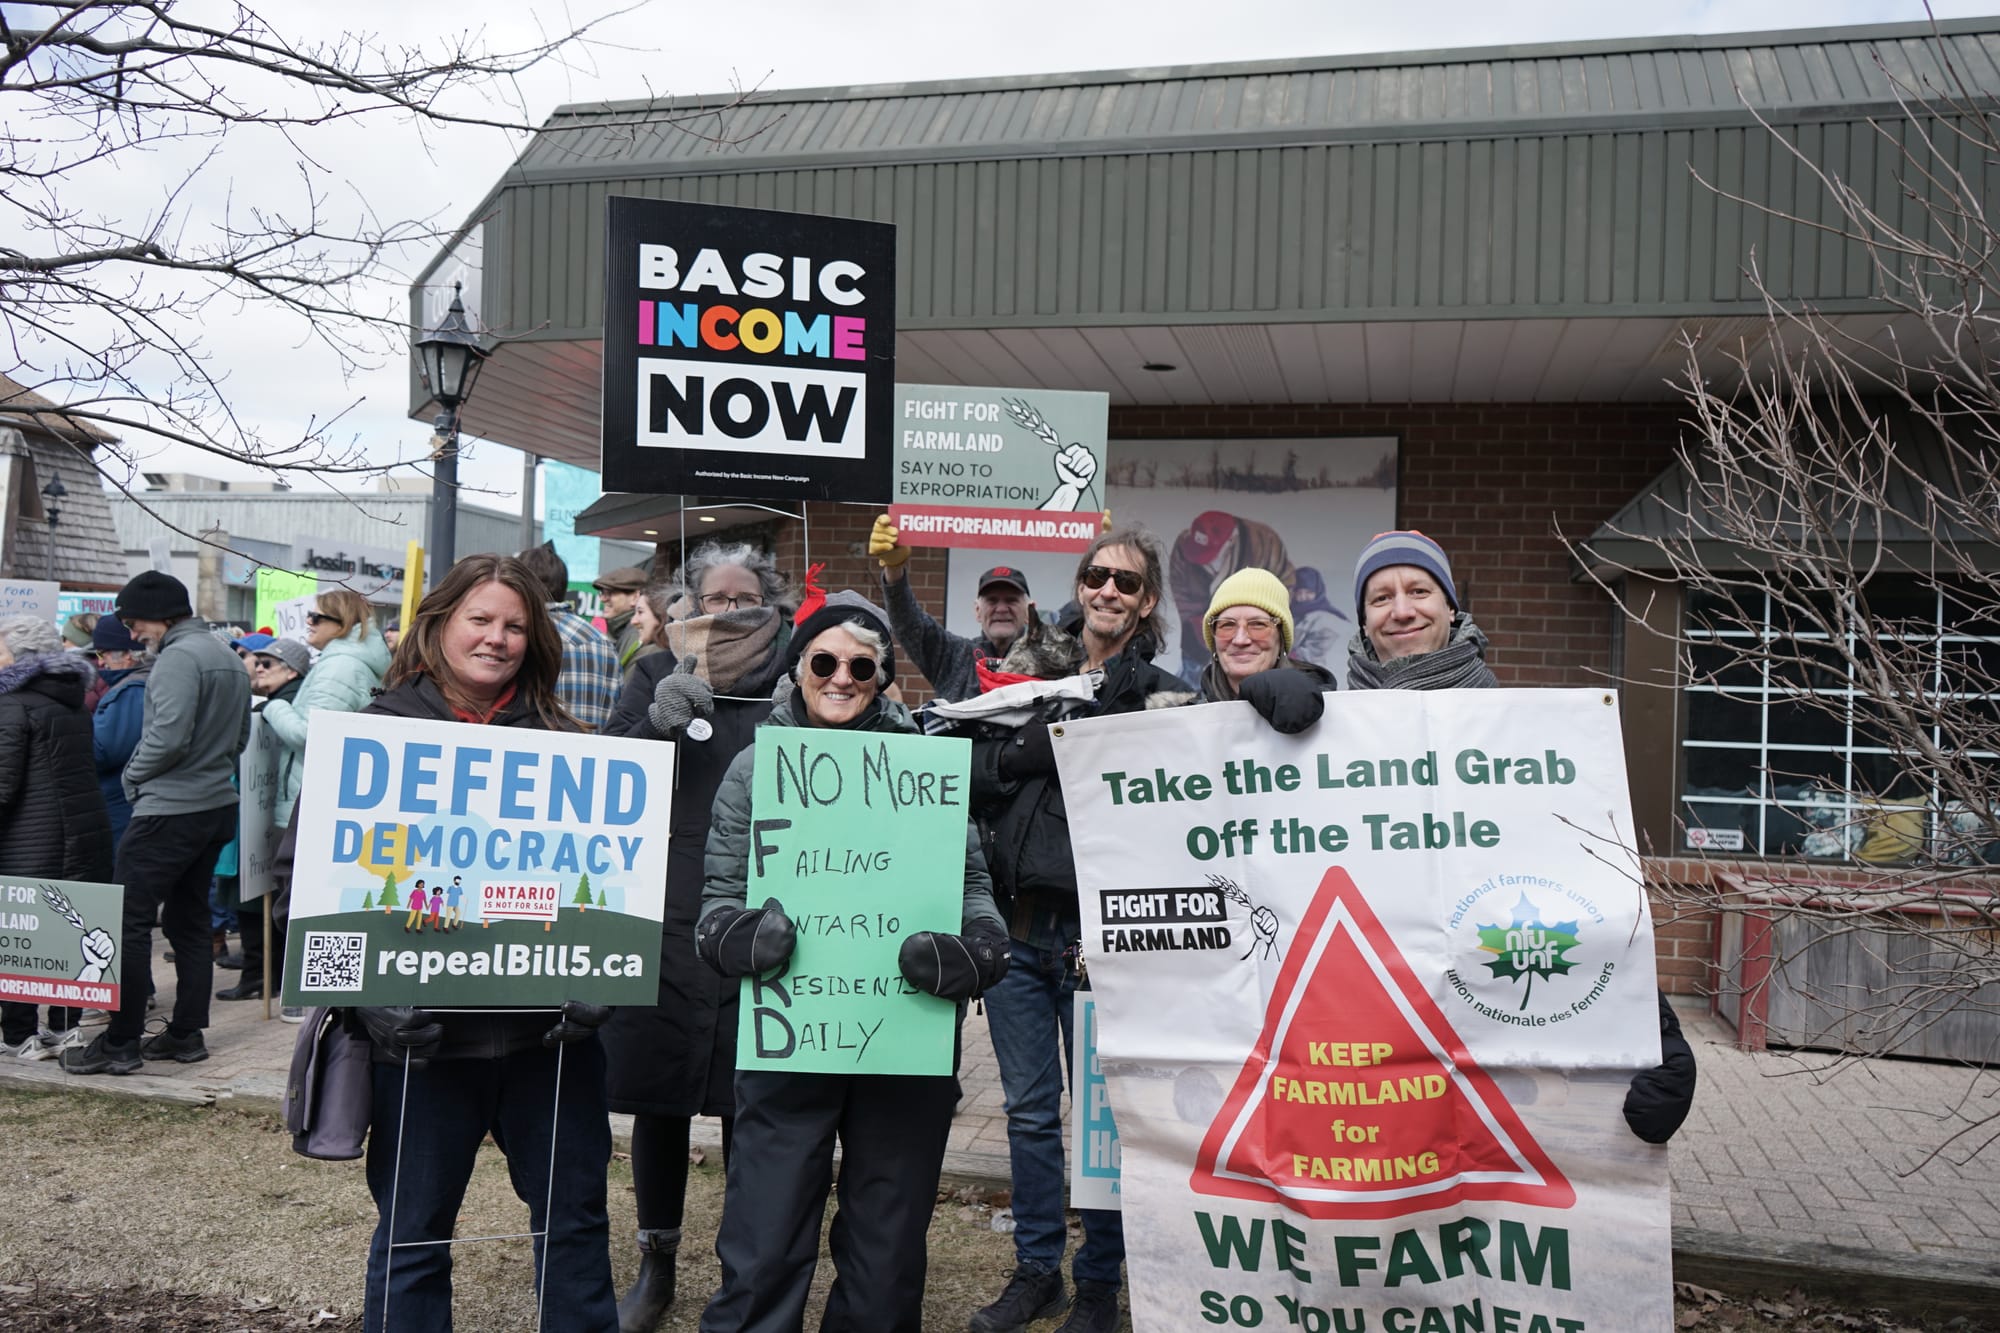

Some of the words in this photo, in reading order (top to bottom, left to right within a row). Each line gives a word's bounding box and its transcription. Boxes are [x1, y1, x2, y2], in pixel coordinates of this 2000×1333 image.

[639, 243, 867, 306] BASIC
[638, 300, 866, 361] INCOME
[649, 373, 858, 444] NOW
[904, 400, 958, 420] FIGHT
[963, 402, 1000, 422] FOR
[903, 430, 1003, 453] FARMLAND
[901, 461, 934, 475] SAY
[938, 462, 964, 476] NO
[970, 464, 993, 478] TO
[900, 482, 1039, 501] EXPROPRIATION!
[900, 514, 1095, 540] FIGHTFORFARMLAND.COM
[81, 599, 114, 612] PRIVA
[338, 737, 647, 826] DEFEND
[776, 743, 843, 808] NO
[863, 741, 960, 812] MORE
[1101, 768, 1213, 805] Take
[1222, 759, 1301, 795] the
[1317, 751, 1438, 789] Land
[1455, 748, 1576, 785] Grab
[332, 819, 644, 875] DEMOCRACY
[1187, 818, 1259, 861] Off
[1270, 817, 1349, 854] the
[1362, 811, 1500, 851] Table
[8, 886, 36, 904] FOR
[484, 886, 555, 900] ONTARIO
[534, 902, 553, 910] SALE
[1106, 893, 1168, 919] FIGHT
[1175, 892, 1220, 917] FOR
[1450, 878, 1497, 930] national
[1498, 874, 1563, 892] farmers
[1566, 889, 1605, 924] union
[795, 913, 901, 938] NTARIO
[1102, 927, 1232, 953] FARMLAND
[1505, 920, 1546, 951] nfu
[14, 937, 31, 950] TO
[1512, 940, 1558, 971] unf
[0, 954, 69, 972] PRIATION!
[377, 943, 643, 983] repealBill5.ca
[1447, 969, 1475, 1004] union
[1473, 1001, 1546, 1027] nationale
[1550, 1010, 1572, 1023] des
[1571, 961, 1615, 1015] fermiers
[753, 1007, 884, 1064] DAILY
[1308, 1042, 1393, 1067] KEEP
[1273, 1074, 1447, 1105] FARMLAND
[1331, 1119, 1380, 1143] for
[1293, 1152, 1440, 1182] FARMING
[1193, 1210, 1312, 1284] WE
[1334, 1216, 1571, 1291] FARM
[1200, 1290, 1264, 1328] SO
[1275, 1294, 1366, 1333] YOU
[1382, 1298, 1485, 1333] CAN
